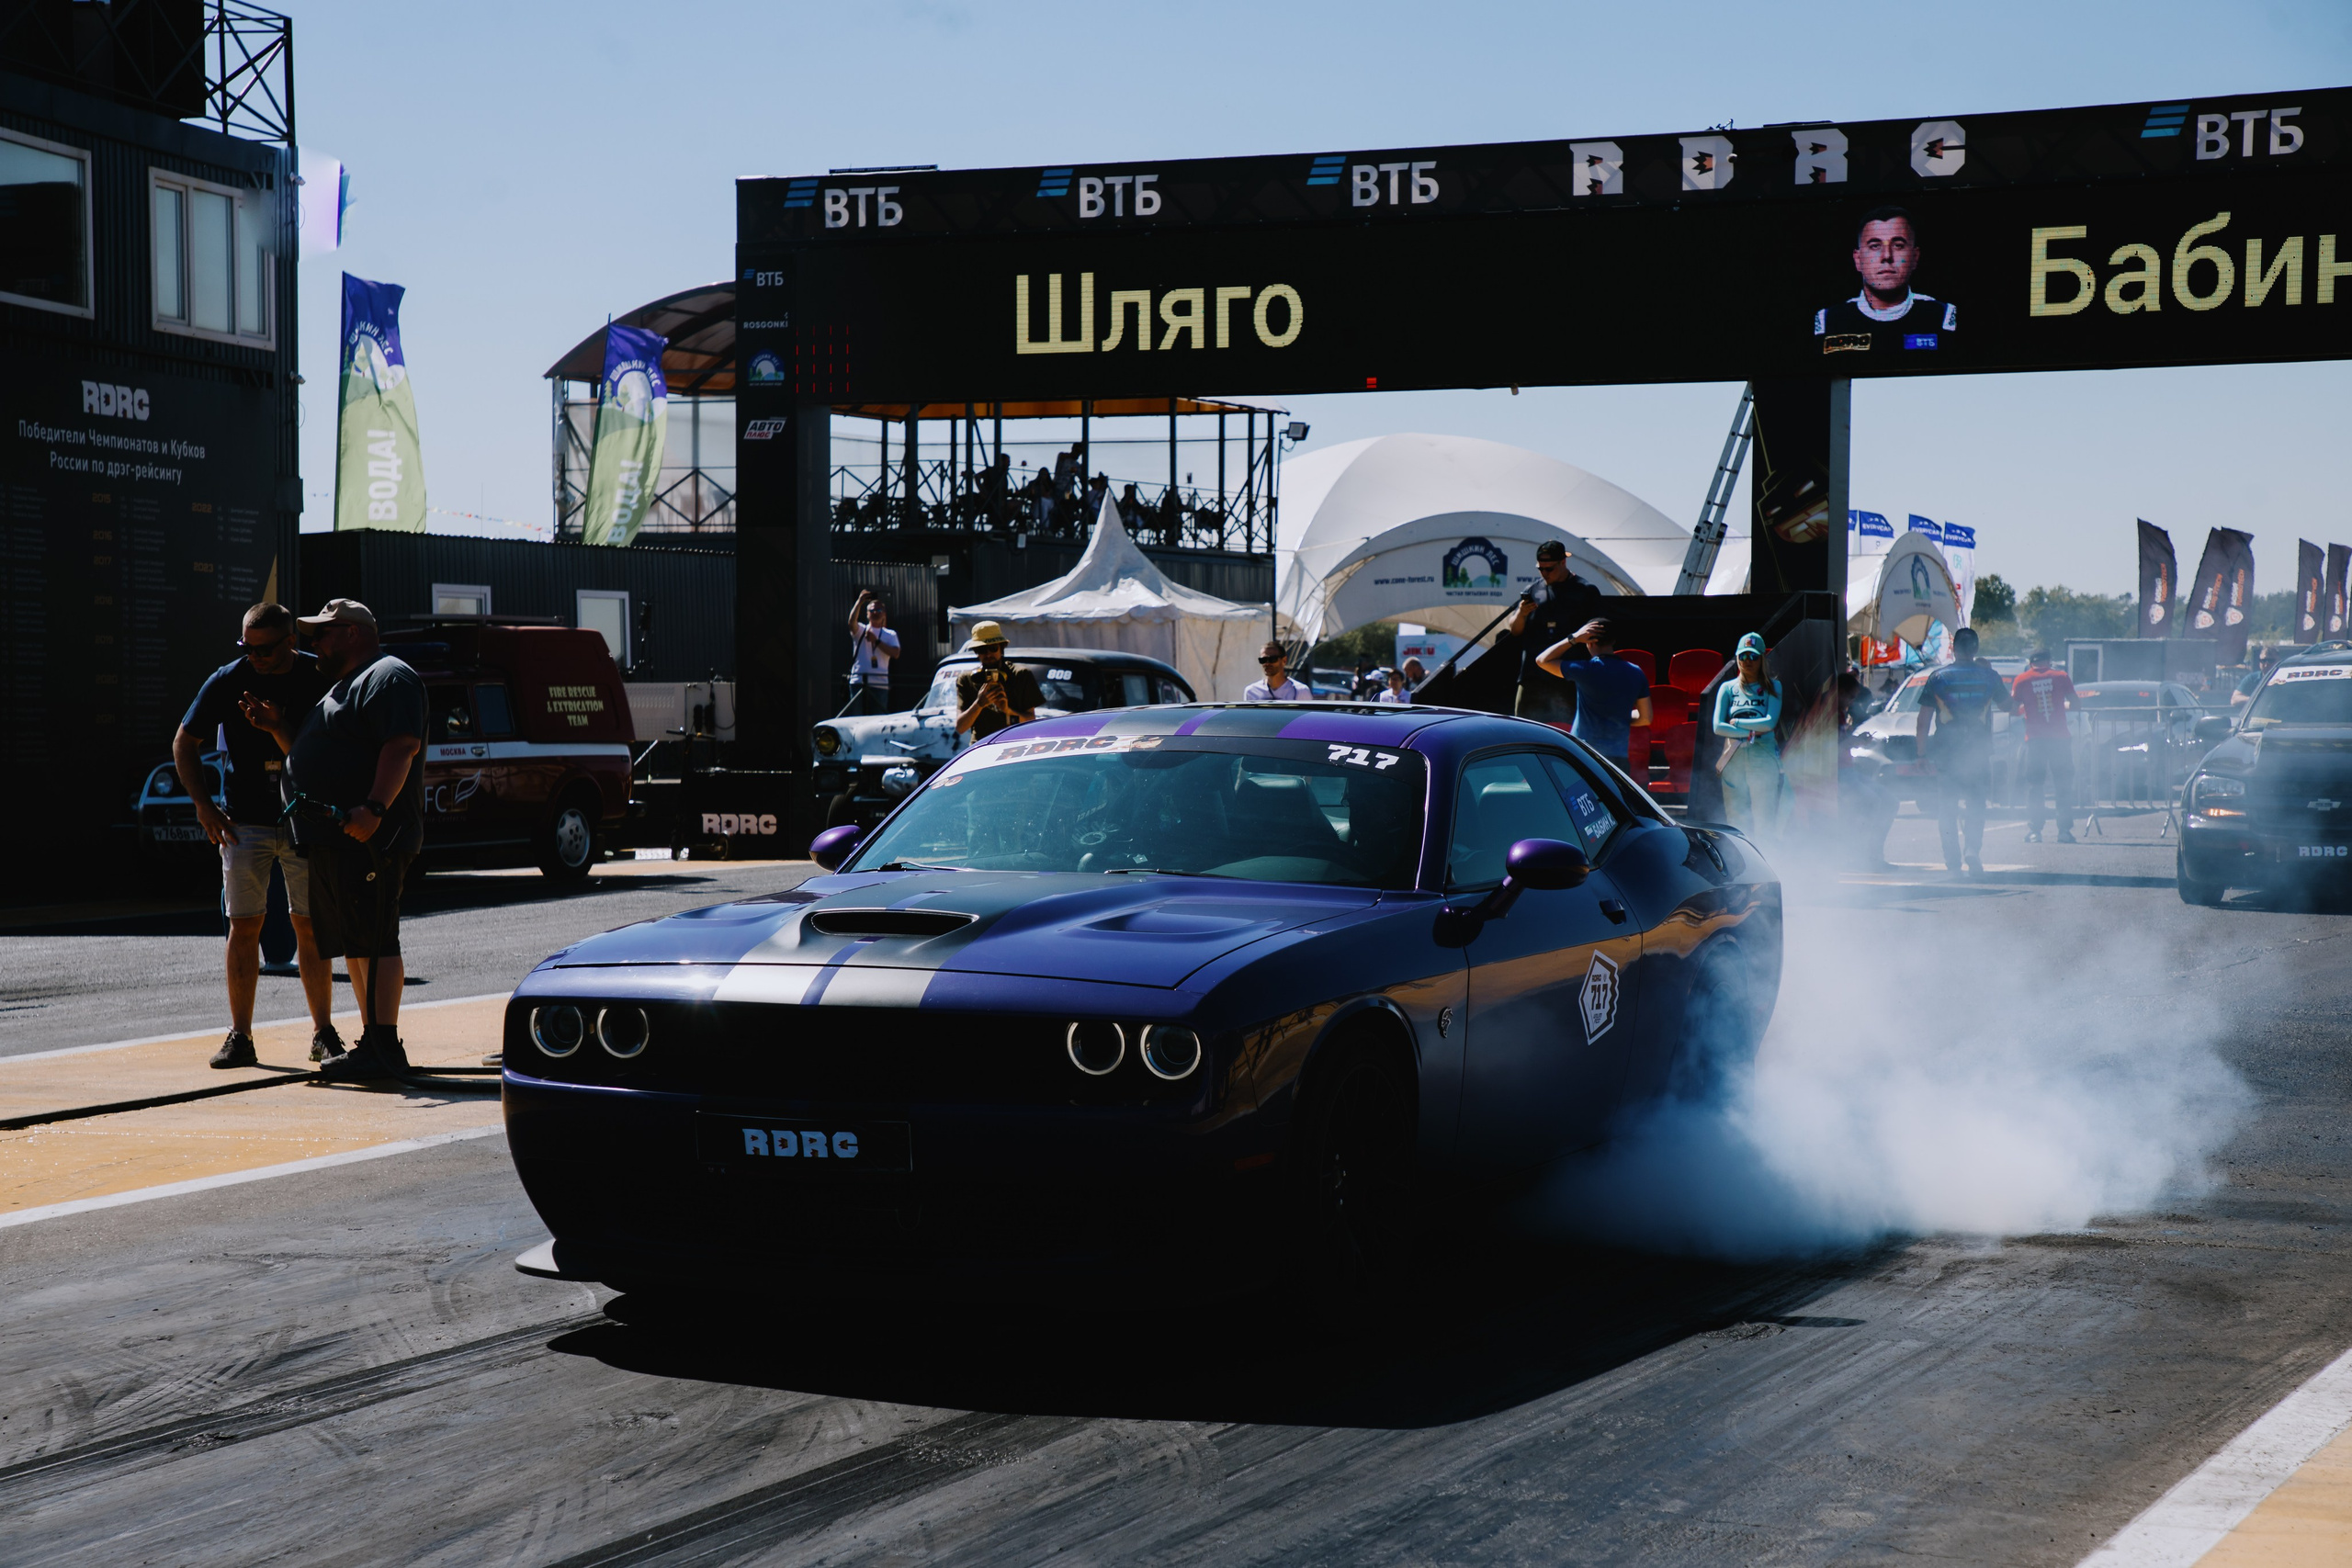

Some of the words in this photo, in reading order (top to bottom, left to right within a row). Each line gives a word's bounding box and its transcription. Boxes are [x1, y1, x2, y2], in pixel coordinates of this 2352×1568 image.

[2196, 106, 2304, 161] ВТБ
[1351, 160, 1440, 208] ВТБ
[1079, 174, 1162, 219] ВТБ
[824, 185, 904, 229] ВТБ
[756, 270, 784, 287] ВТБ
[1016, 271, 1304, 355] Шляго
[742, 320, 788, 330] ROSGONKI
[81, 380, 150, 422] RDRC
[748, 420, 783, 432] АВТО
[18, 419, 86, 446] Победители
[89, 425, 159, 456] Чемпионатов
[162, 441, 168, 456] и
[171, 438, 206, 460] Кубков
[746, 431, 772, 439] ПЛЮС
[50, 451, 89, 473] России
[92, 459, 105, 475] по
[107, 458, 183, 485] дрэг-рейсингу
[368, 428, 403, 522] ВОДА!
[92, 492, 111, 504] 2015
[191, 502, 212, 513] 2022
[93, 530, 112, 542] 2016
[94, 556, 112, 566] 2017
[1451, 545, 1486, 566] ШИШКИН
[1487, 549, 1500, 566] ЛЕС
[193, 561, 214, 573] 2023
[1046, 669, 1073, 681] 808
[2286, 669, 2344, 680] RDRC
[548, 685, 568, 698] FIRE
[568, 685, 596, 698] RESCUE
[547, 701, 554, 713] &
[553, 699, 604, 713] EXTRICATION
[1730, 699, 1766, 707] BLACK
[567, 715, 589, 727] TEAM
[440, 748, 467, 757] МОСКВА
[995, 736, 1119, 761] RDRC
[1328, 743, 1400, 770] 717
[1577, 793, 1595, 818] ВТБ
[701, 813, 777, 836] RDRC
[2298, 845, 2348, 857] RDRC
[1591, 983, 1609, 1010] 717
[741, 1128, 859, 1159] RDRC
